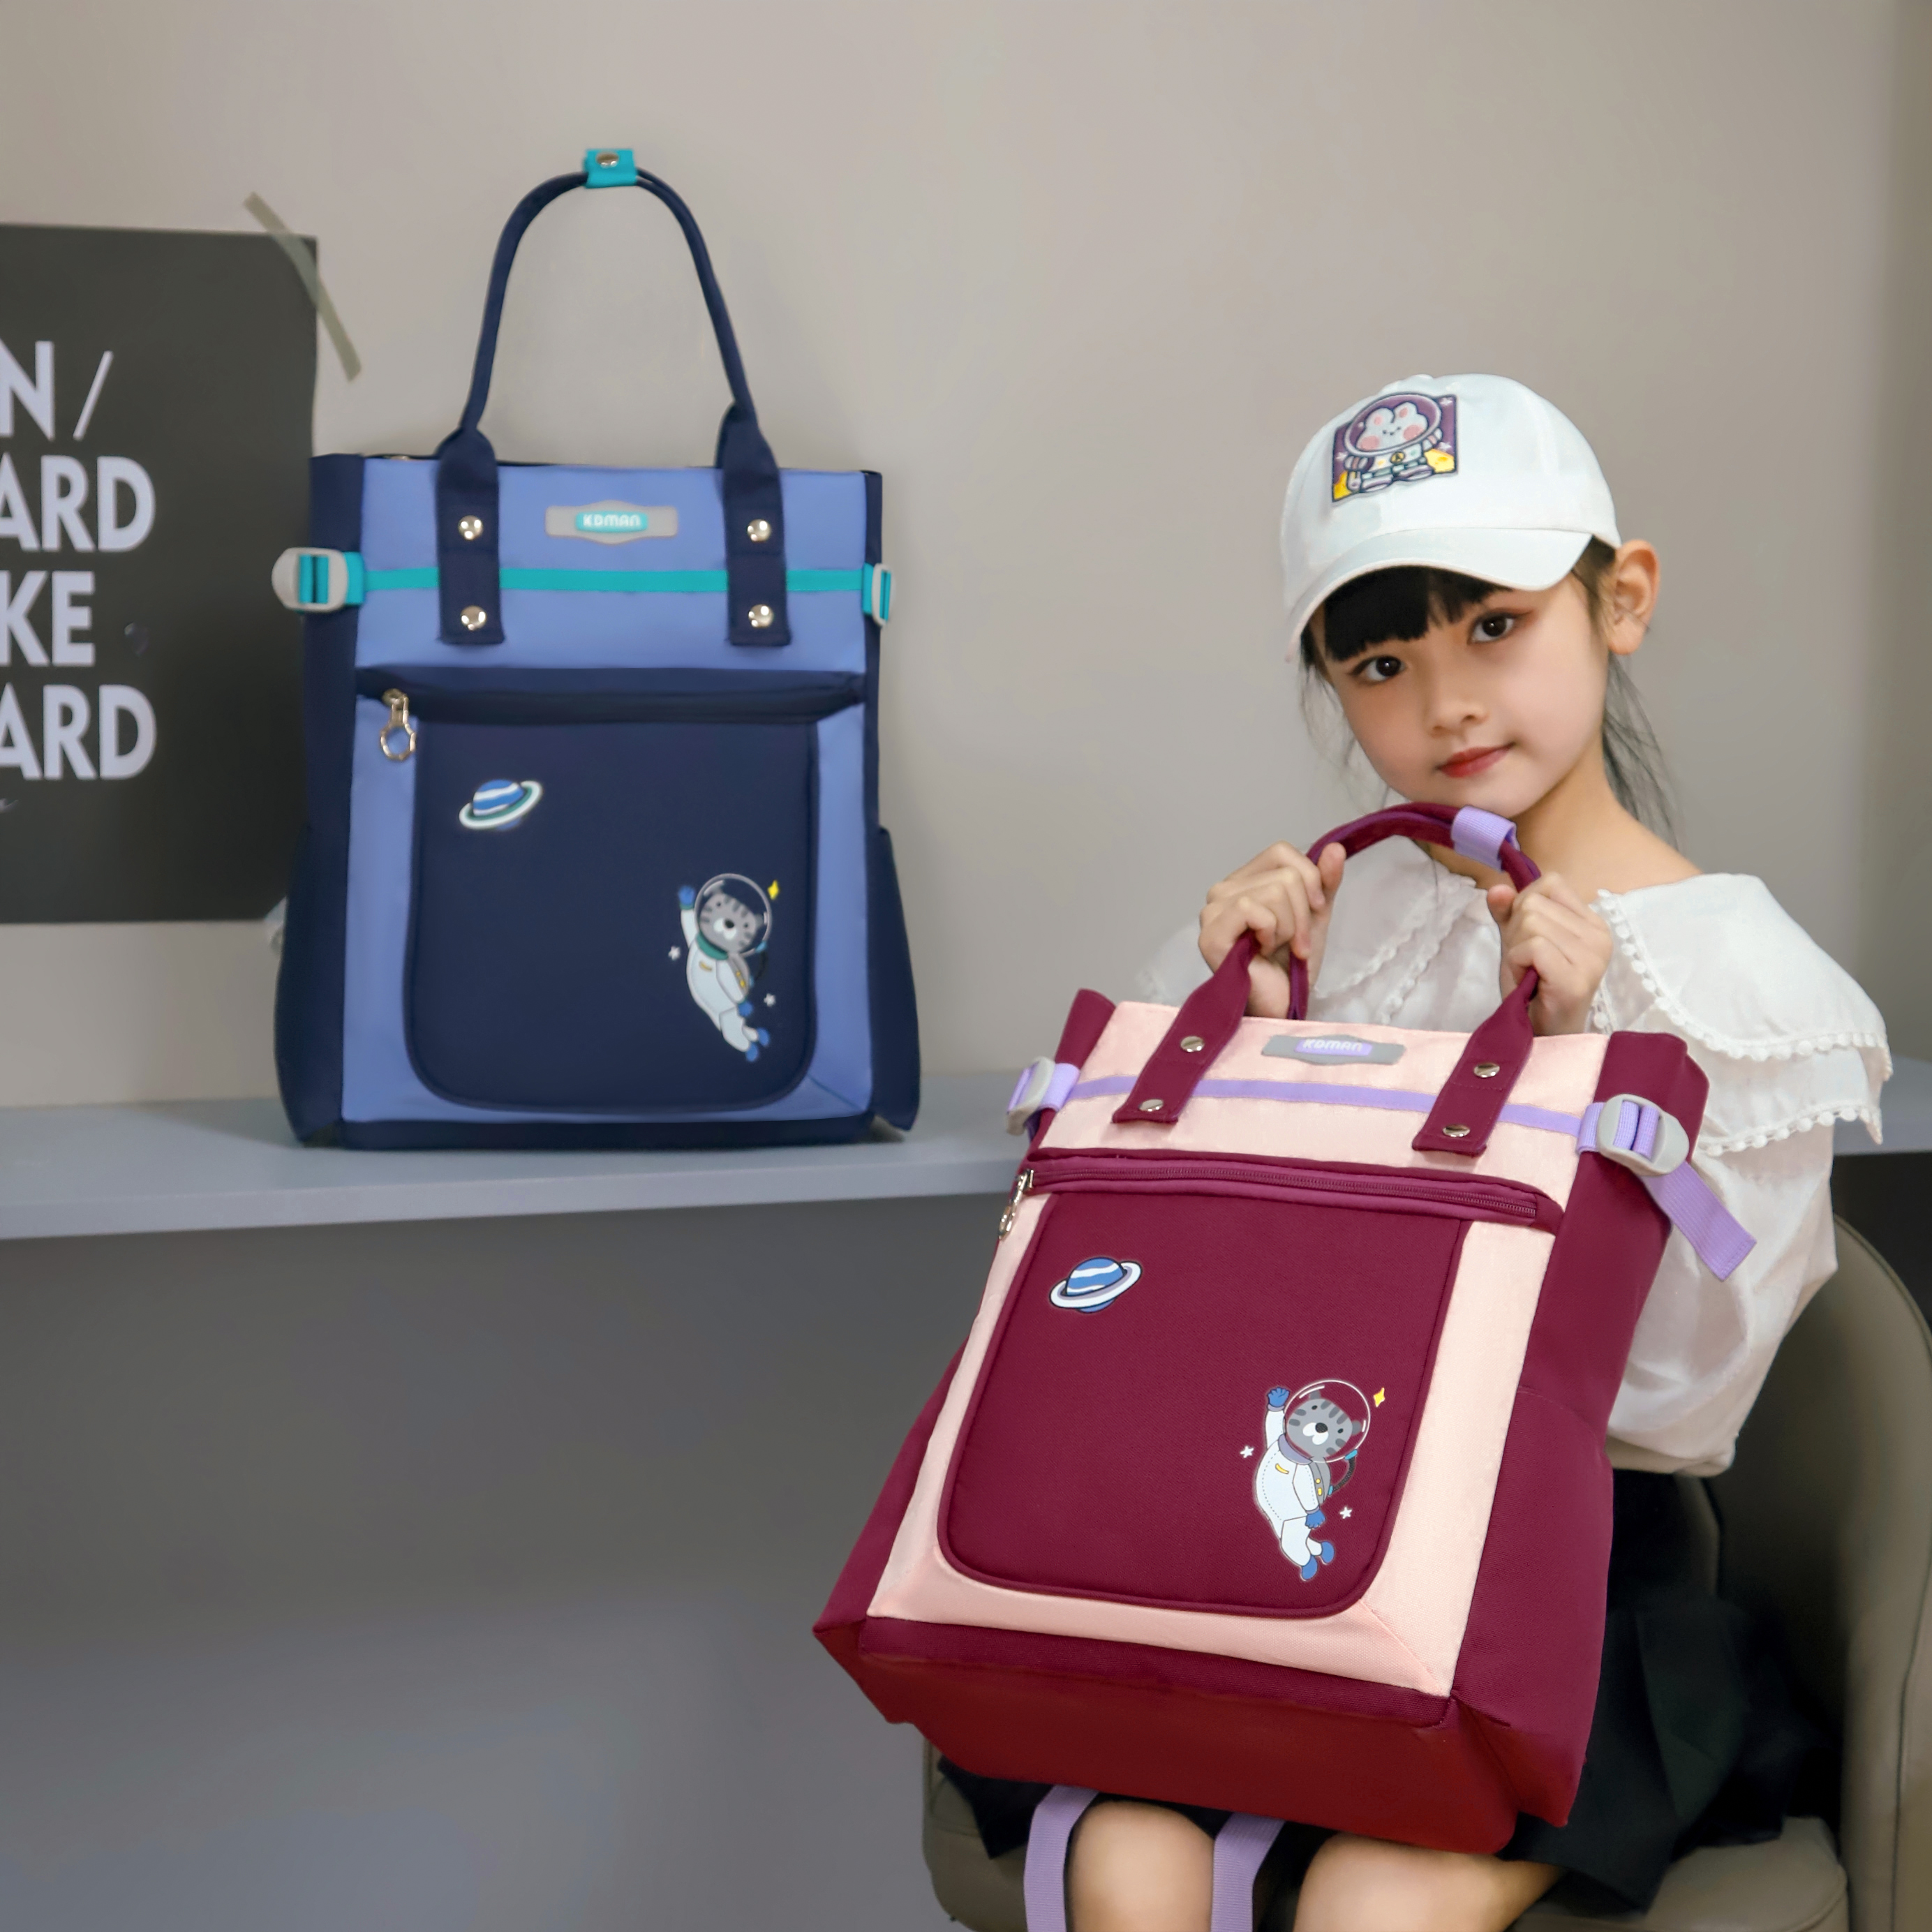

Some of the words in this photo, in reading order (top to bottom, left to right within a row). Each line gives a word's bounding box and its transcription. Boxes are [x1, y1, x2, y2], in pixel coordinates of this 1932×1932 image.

[0, 453, 155, 552] ARD
[0, 570, 96, 666] KE
[0, 682, 156, 780] ARD
